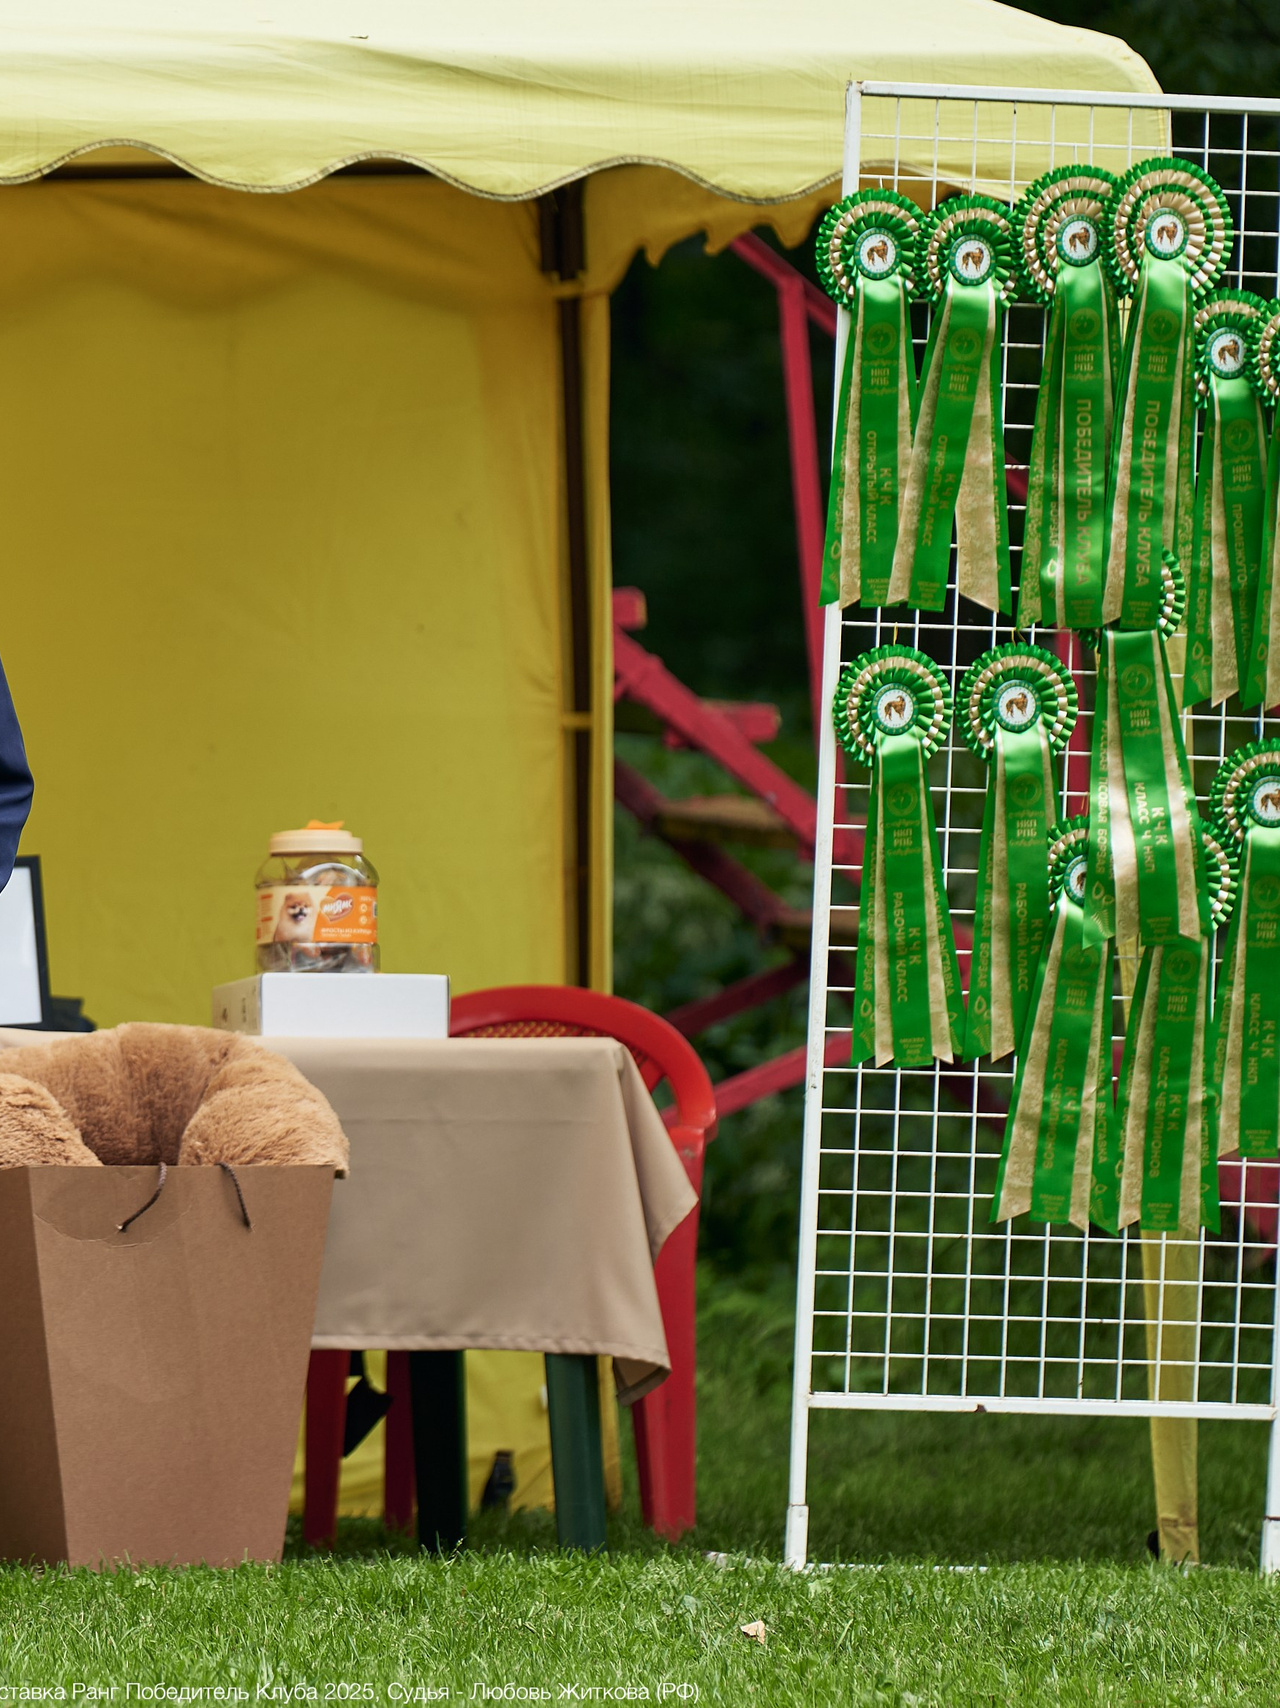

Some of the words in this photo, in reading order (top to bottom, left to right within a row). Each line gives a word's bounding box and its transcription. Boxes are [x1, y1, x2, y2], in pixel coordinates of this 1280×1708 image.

[867, 430, 878, 502] ОТКРЫТЫЙ
[929, 434, 948, 504] ОТКРЫТЫЙ
[1074, 400, 1092, 522] ПОБЕДИТЕЛЬ
[1138, 400, 1160, 523] ПОБЕДИТЕЛЬ
[866, 504, 876, 544] КЛАСС
[922, 506, 935, 546] КЛАСС
[1076, 526, 1092, 586] КЛУБА
[1135, 527, 1151, 587] КЛУБА
[1195, 588, 1207, 634] БОРЗАЯ
[1098, 777, 1108, 823] ПСОВАЯ
[1134, 782, 1150, 824] КЛАСС
[1096, 828, 1108, 874] БОРЗАЯ
[1142, 830, 1152, 840] Ч
[1144, 846, 1156, 873] НКП
[893, 892, 908, 956] РАБОЧИЙ
[982, 889, 992, 938] ПСОВАЯ
[1016, 882, 1029, 946] РАБОЧИЙ
[863, 946, 874, 992] БОРЗАЯ
[896, 960, 908, 1003] КЛАСС
[939, 935, 954, 996] ВЫСТАВКА
[978, 942, 989, 989] БОРЗАЯ
[1018, 950, 1028, 992] КЛАСС
[1249, 993, 1260, 1036] КЛАСС
[1052, 1038, 1068, 1080] КЛАСС
[1156, 1046, 1170, 1089] КЛАСС
[1249, 1042, 1258, 1051] Ч
[1248, 1057, 1258, 1085] НКП
[1042, 1083, 1062, 1170] ЧЕМПИОНОВ
[1096, 1102, 1108, 1164] ВЫСТАВКА
[1149, 1092, 1166, 1178] ЧЕМПИОНОВ
